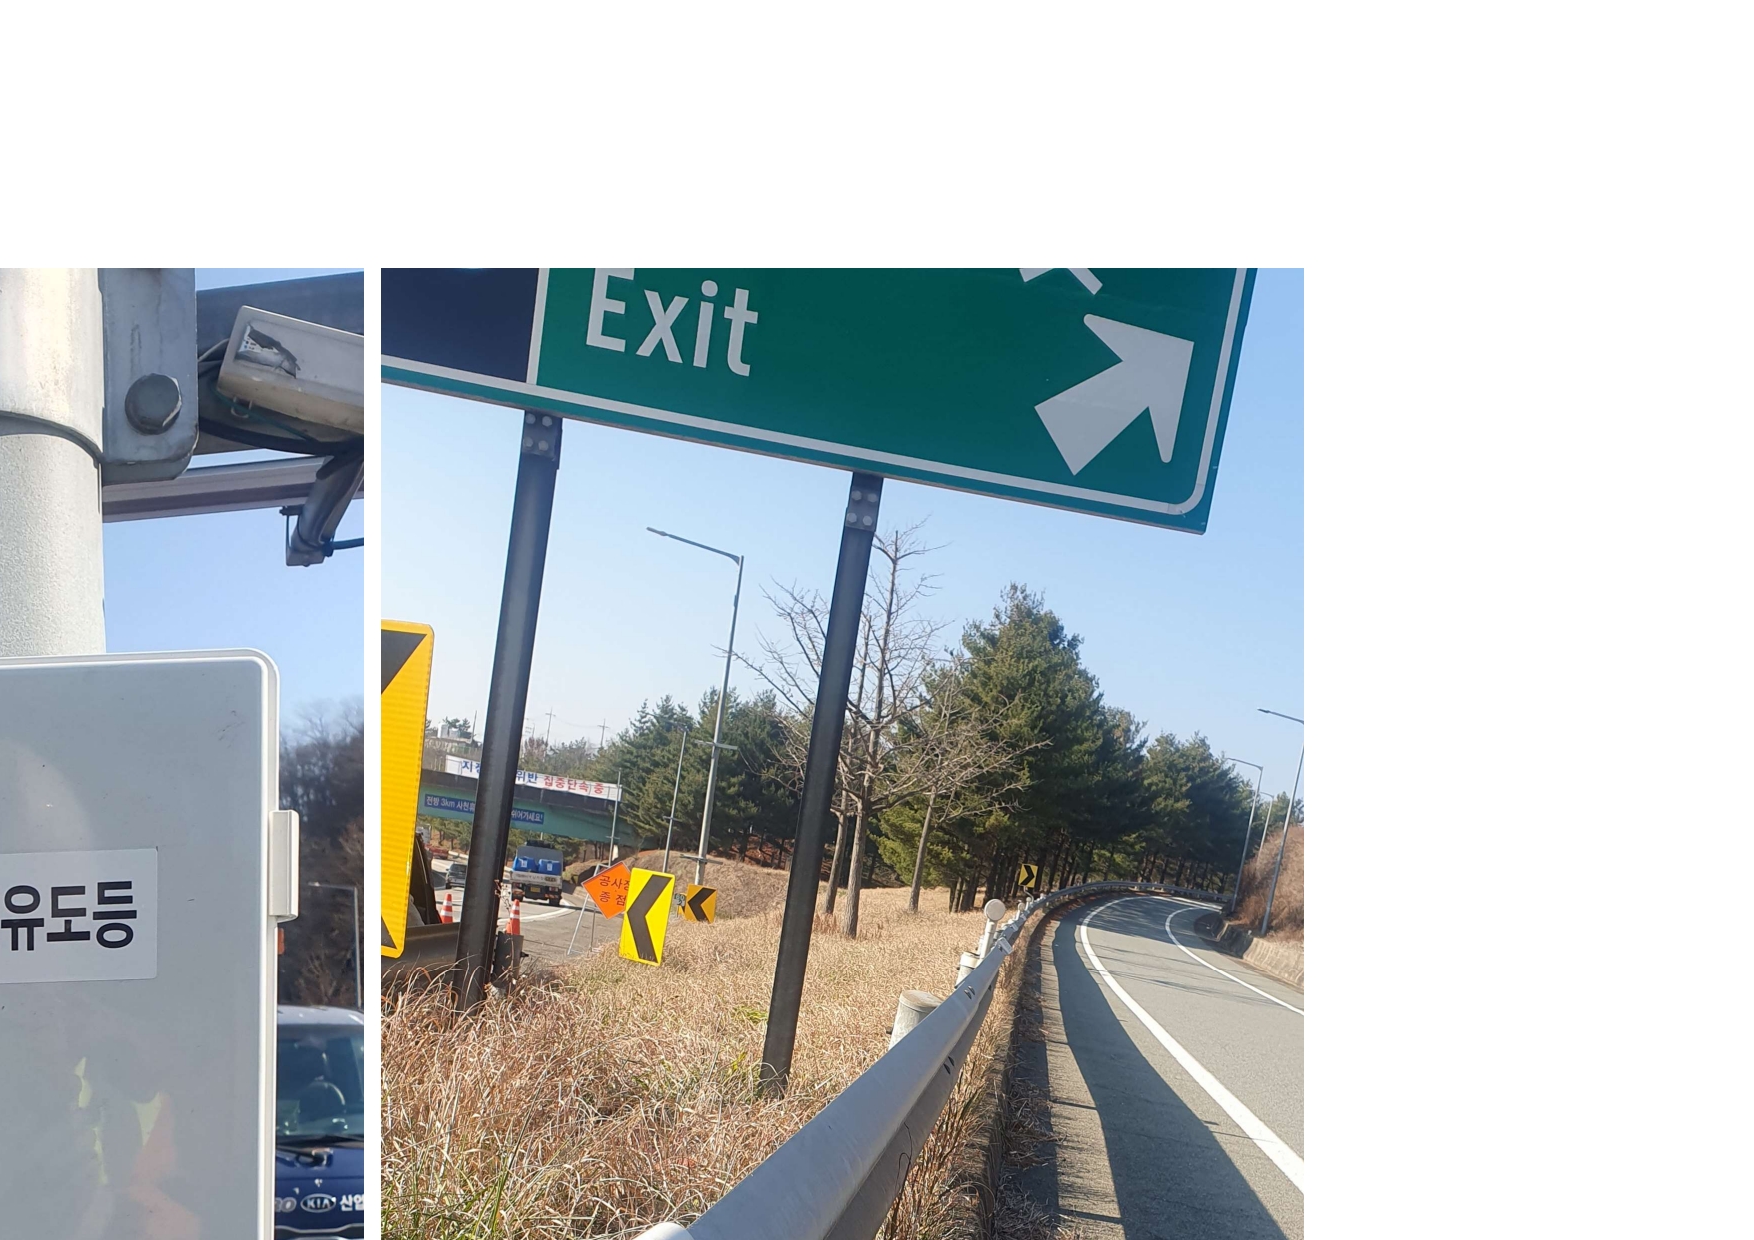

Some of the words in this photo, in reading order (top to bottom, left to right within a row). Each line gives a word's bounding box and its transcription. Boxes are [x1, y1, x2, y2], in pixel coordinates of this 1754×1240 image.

[586, 268, 758, 376] Exit
[516, 769, 538, 784] 위반
[543, 775, 589, 793] 집중단속
[594, 782, 604, 794] 중
